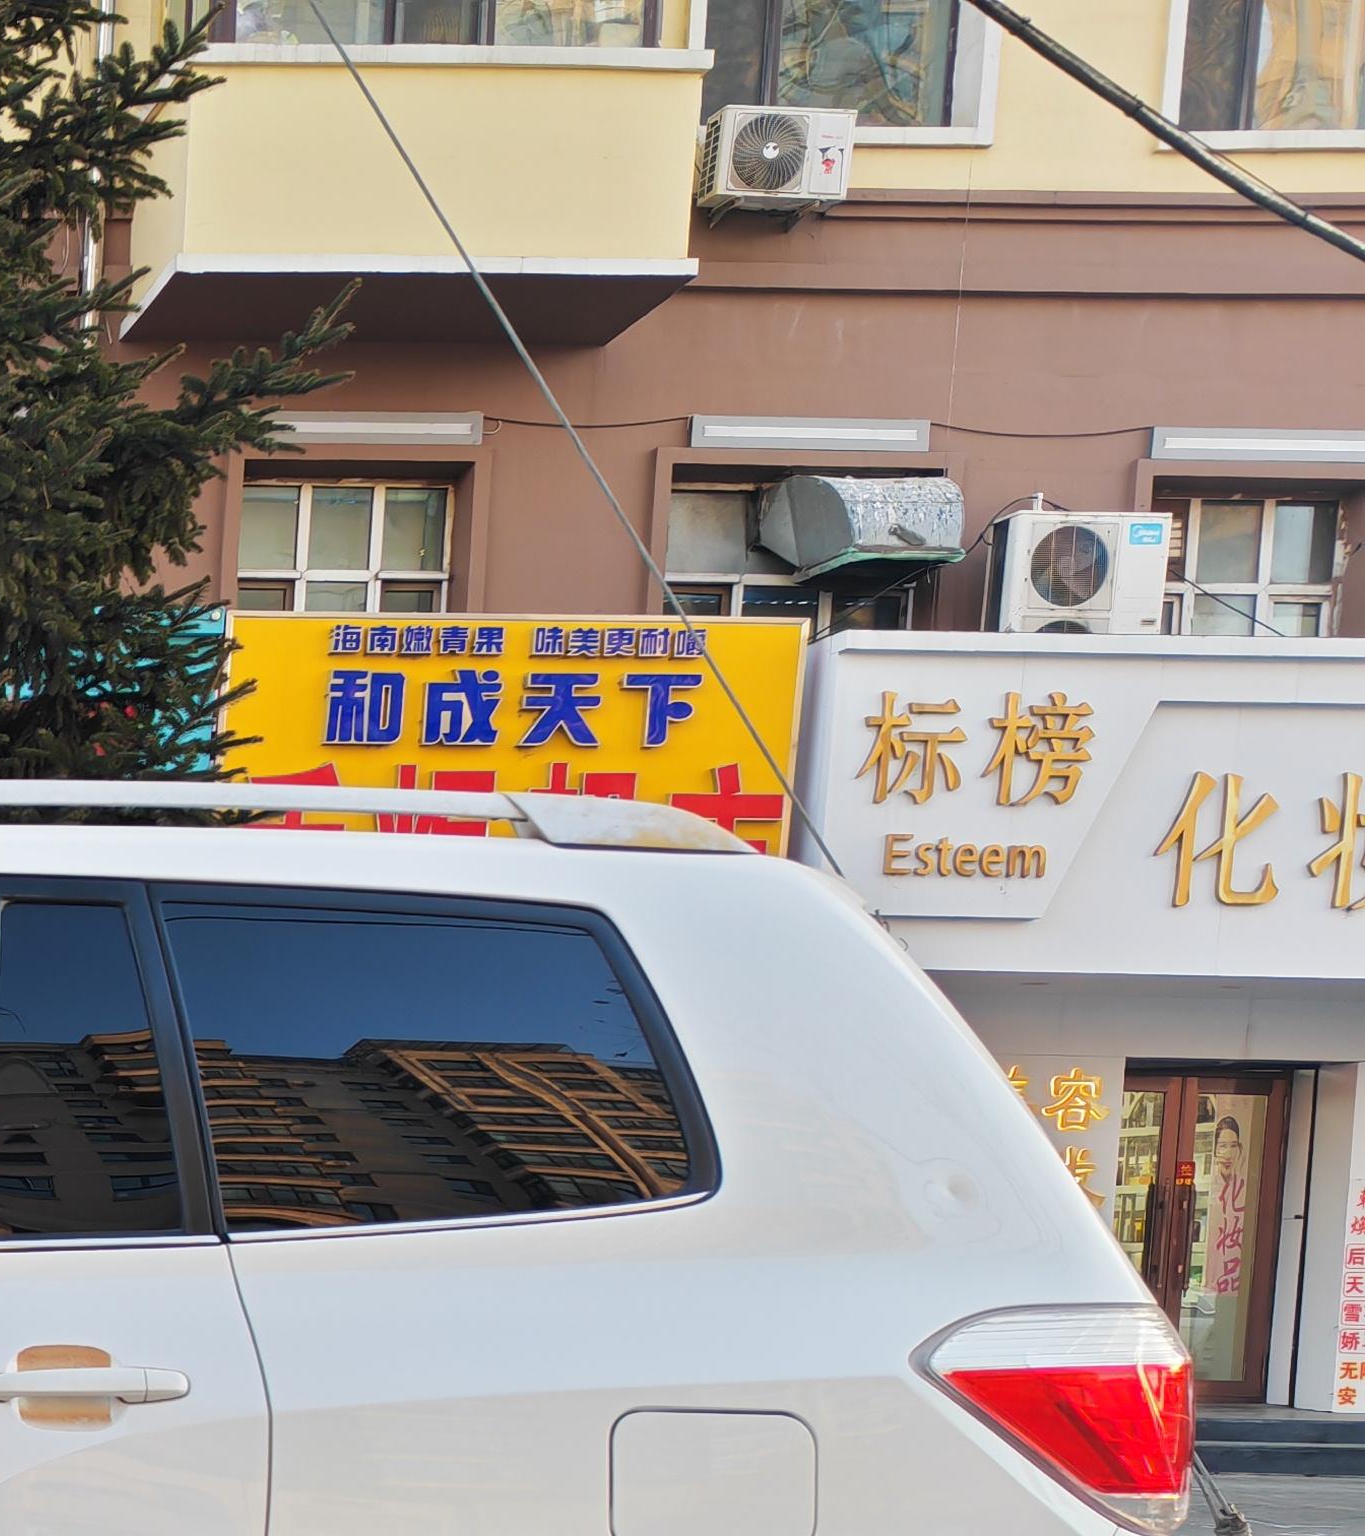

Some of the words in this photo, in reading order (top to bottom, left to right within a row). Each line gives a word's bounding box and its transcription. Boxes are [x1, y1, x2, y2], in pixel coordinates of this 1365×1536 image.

[329, 624, 505, 657] 海南嫩青果
[322, 668, 703, 748] 和成天下
[854, 690, 1095, 808] 标榜
[882, 833, 1048, 879] Esteem
[1343, 1303, 1365, 1323] 雪
[1341, 1331, 1365, 1351] 娇
